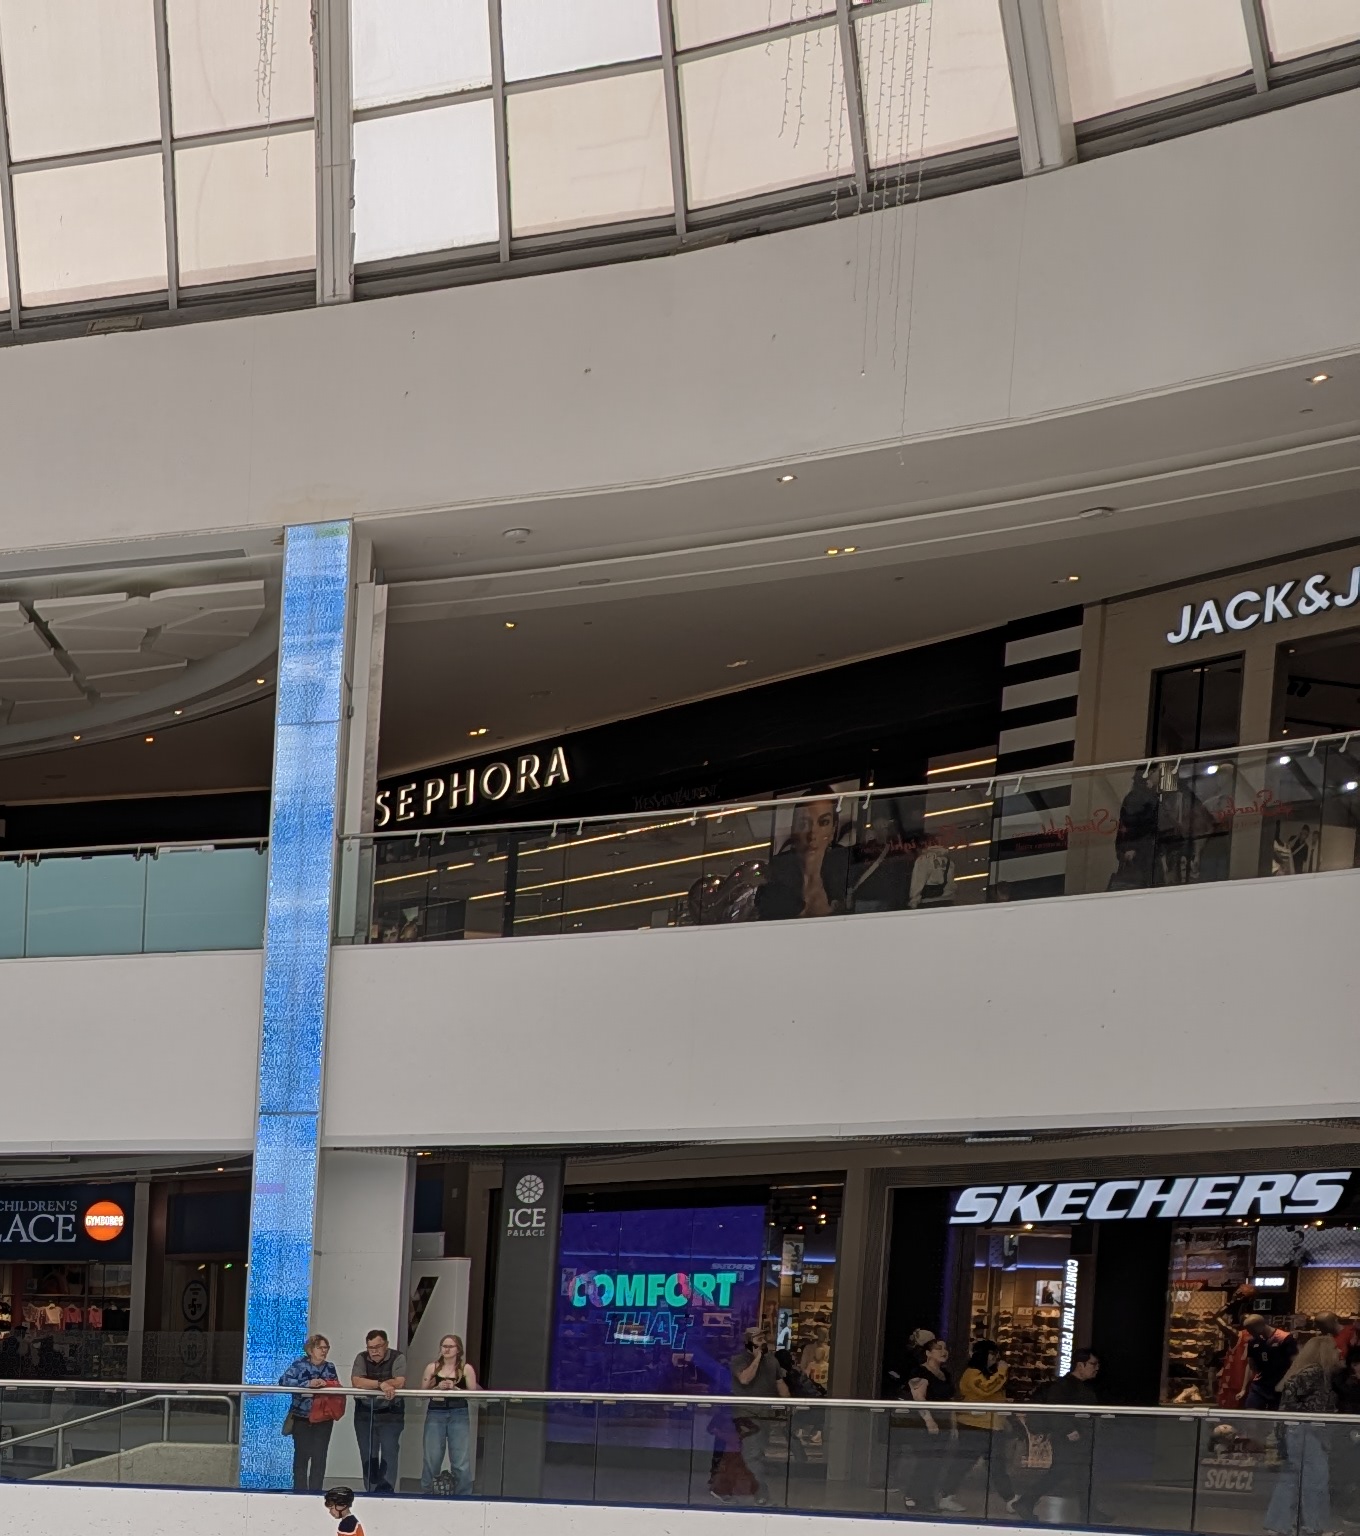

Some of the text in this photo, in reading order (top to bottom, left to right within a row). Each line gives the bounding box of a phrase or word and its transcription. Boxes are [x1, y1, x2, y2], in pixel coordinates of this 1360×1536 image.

[375, 746, 570, 827] SEPHORA
[507, 1208, 546, 1227] ICE
[949, 1171, 1353, 1225] SKECHERS
[507, 1229, 545, 1237] PALACE
[568, 1272, 737, 1308] COMFORT
[1065, 1259, 1078, 1306] COMFORT
[604, 1311, 695, 1350] THAT
